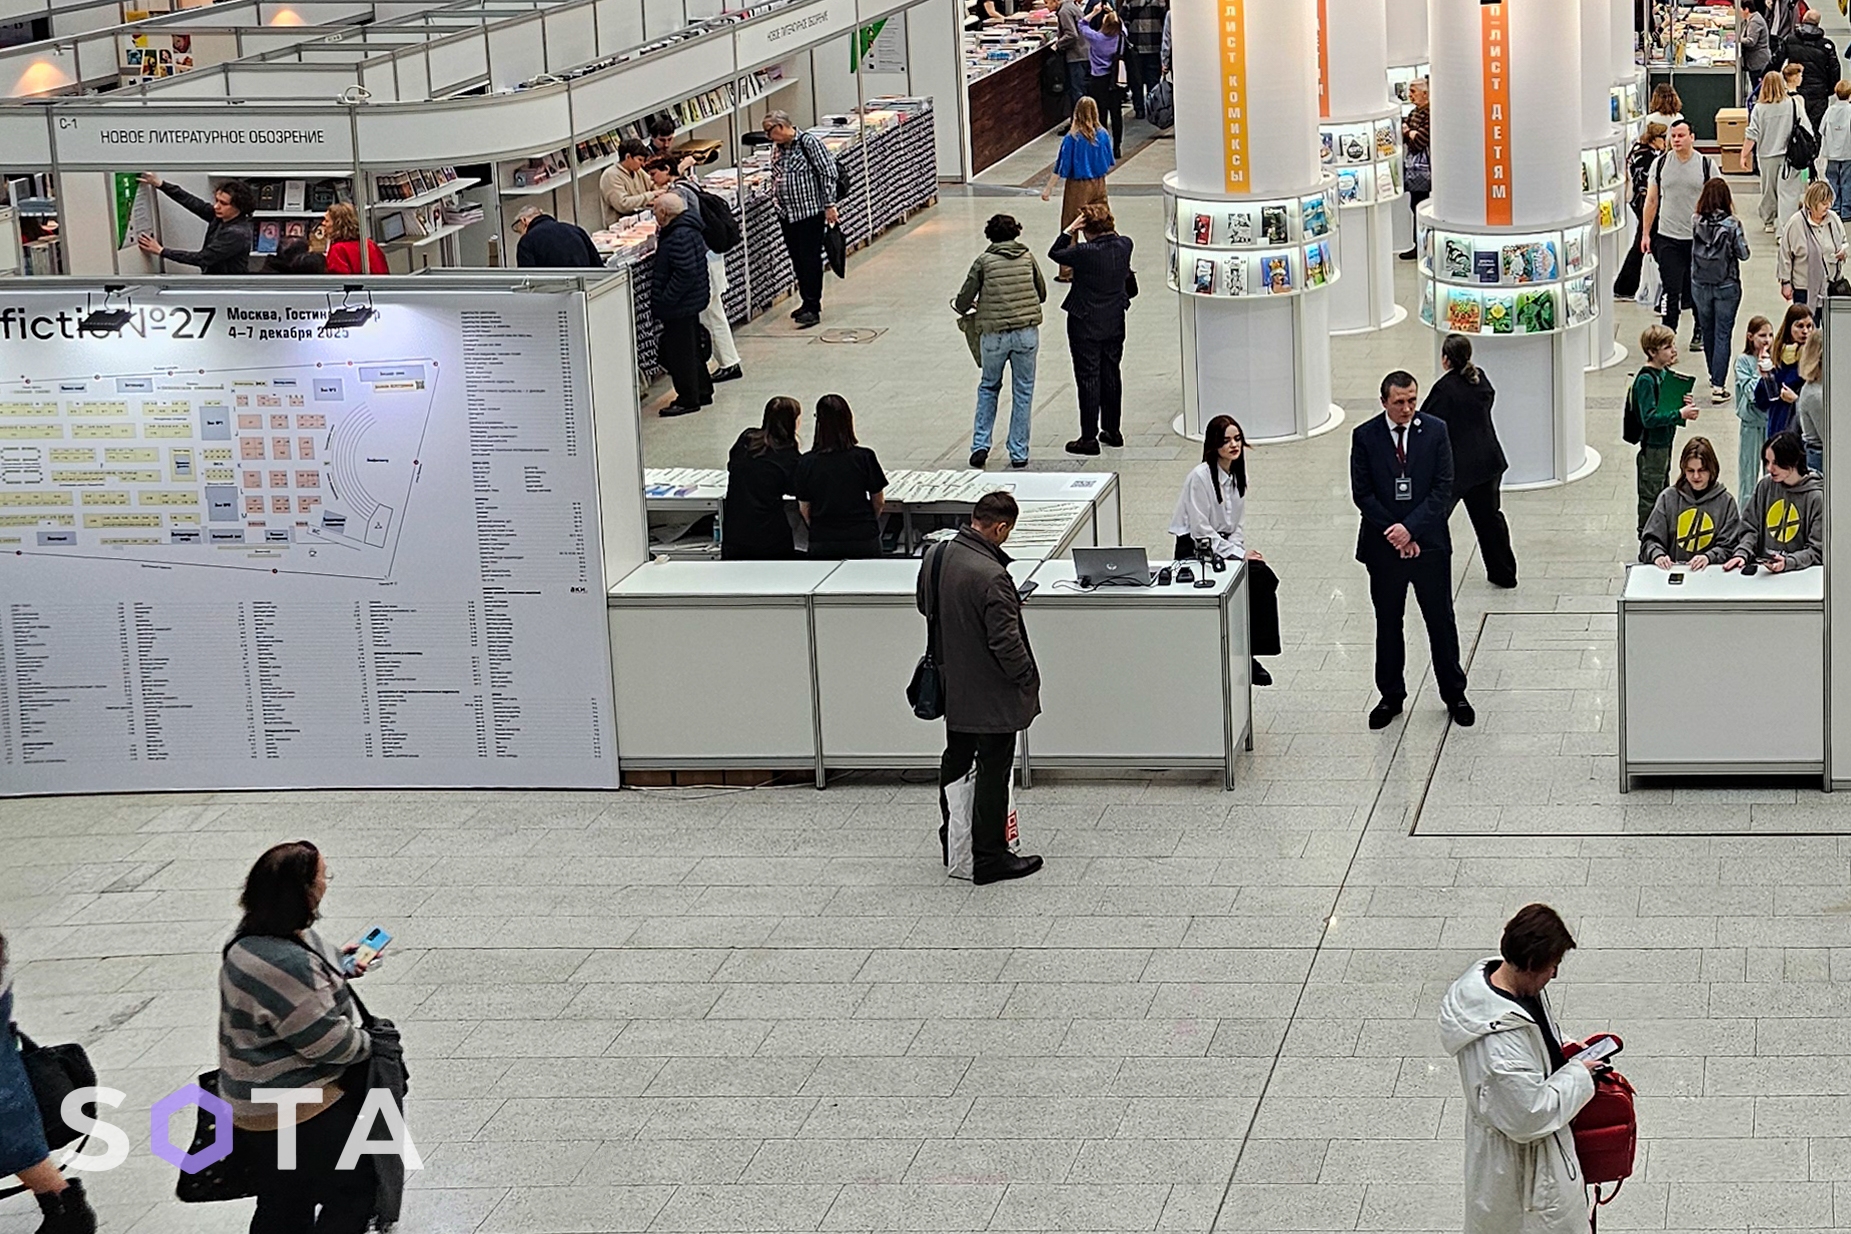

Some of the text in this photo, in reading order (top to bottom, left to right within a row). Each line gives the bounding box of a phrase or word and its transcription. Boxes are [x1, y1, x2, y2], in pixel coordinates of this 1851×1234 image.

[1227, 74, 1244, 183] КОМИКСЫ
[100, 130, 325, 144] НОВОЕ ЛИТЕРАТУРНОЕ ОБОЗРЕНИЕ
[1491, 103, 1507, 200] ДЕТЯМ
[227, 308, 283, 323] Москва,
[259, 326, 313, 342] декабря
